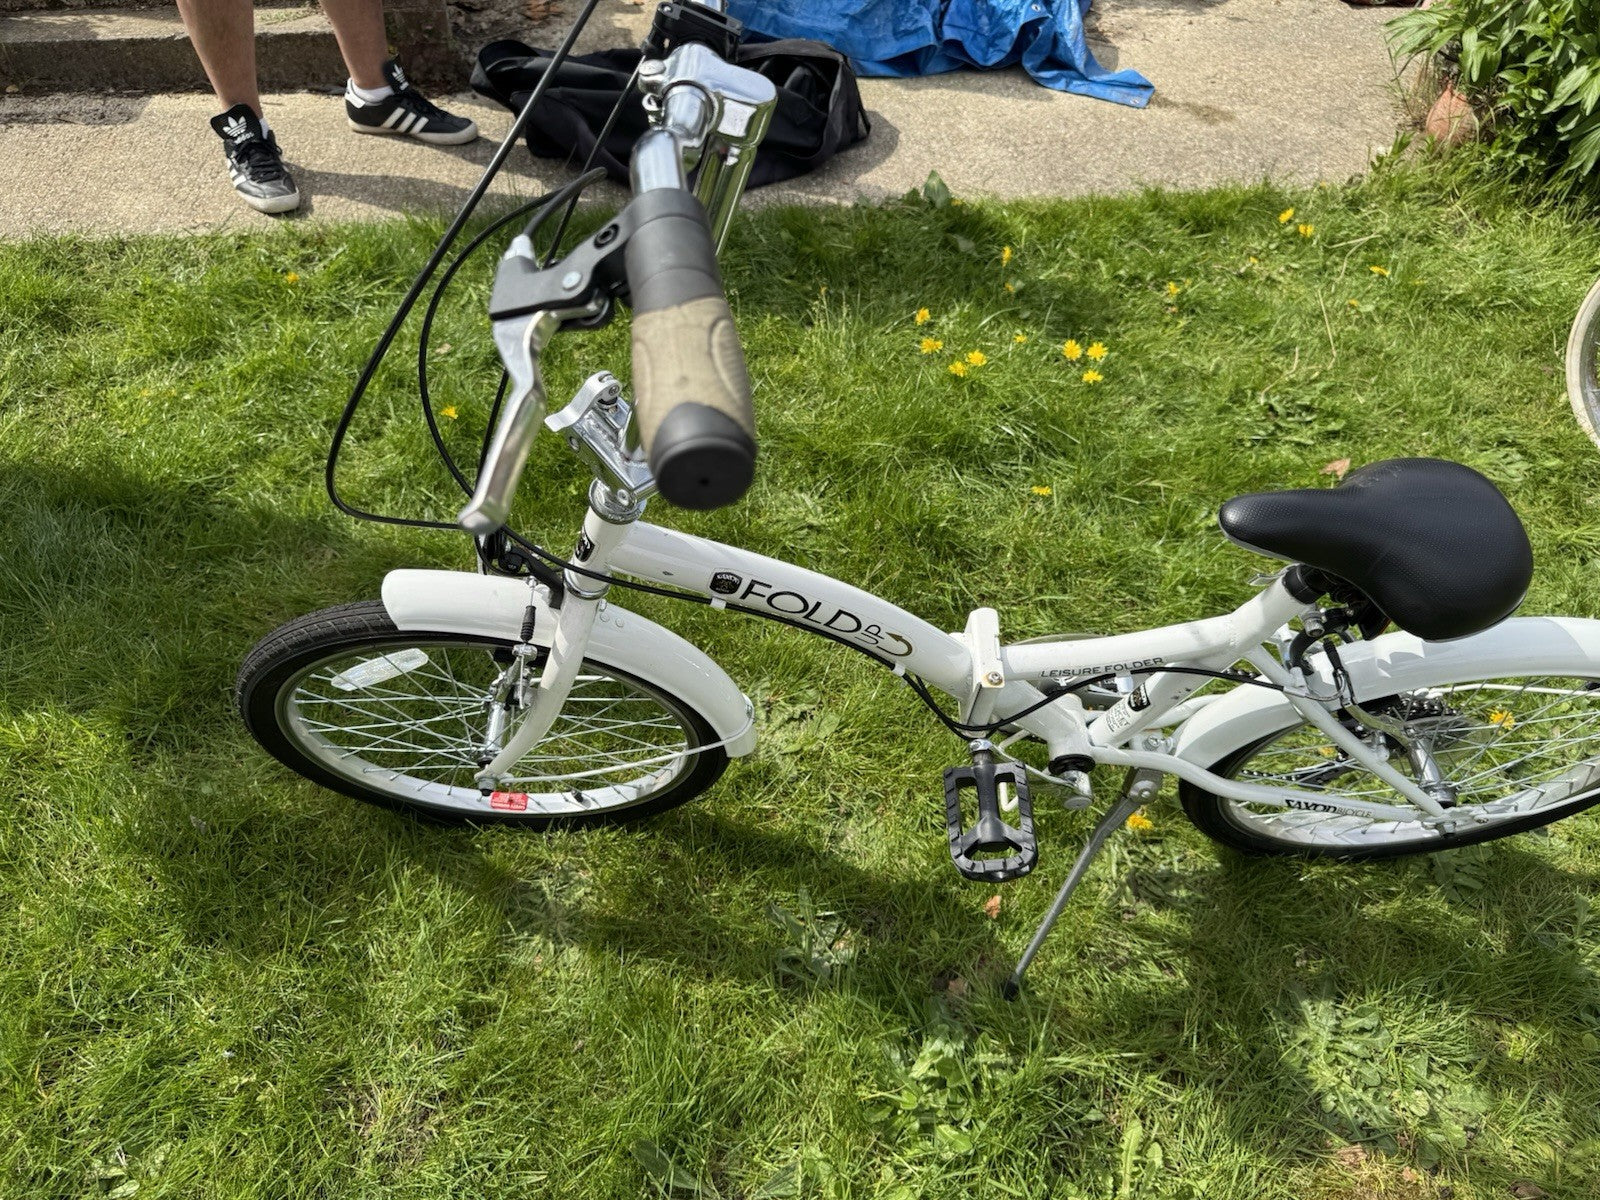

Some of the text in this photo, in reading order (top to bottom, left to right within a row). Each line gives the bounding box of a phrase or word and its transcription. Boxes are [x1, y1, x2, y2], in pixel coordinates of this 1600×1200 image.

[739, 579, 863, 635] FOLD
[854, 624, 888, 647] UP
[1041, 657, 1164, 678] LEISURE FOLDER
